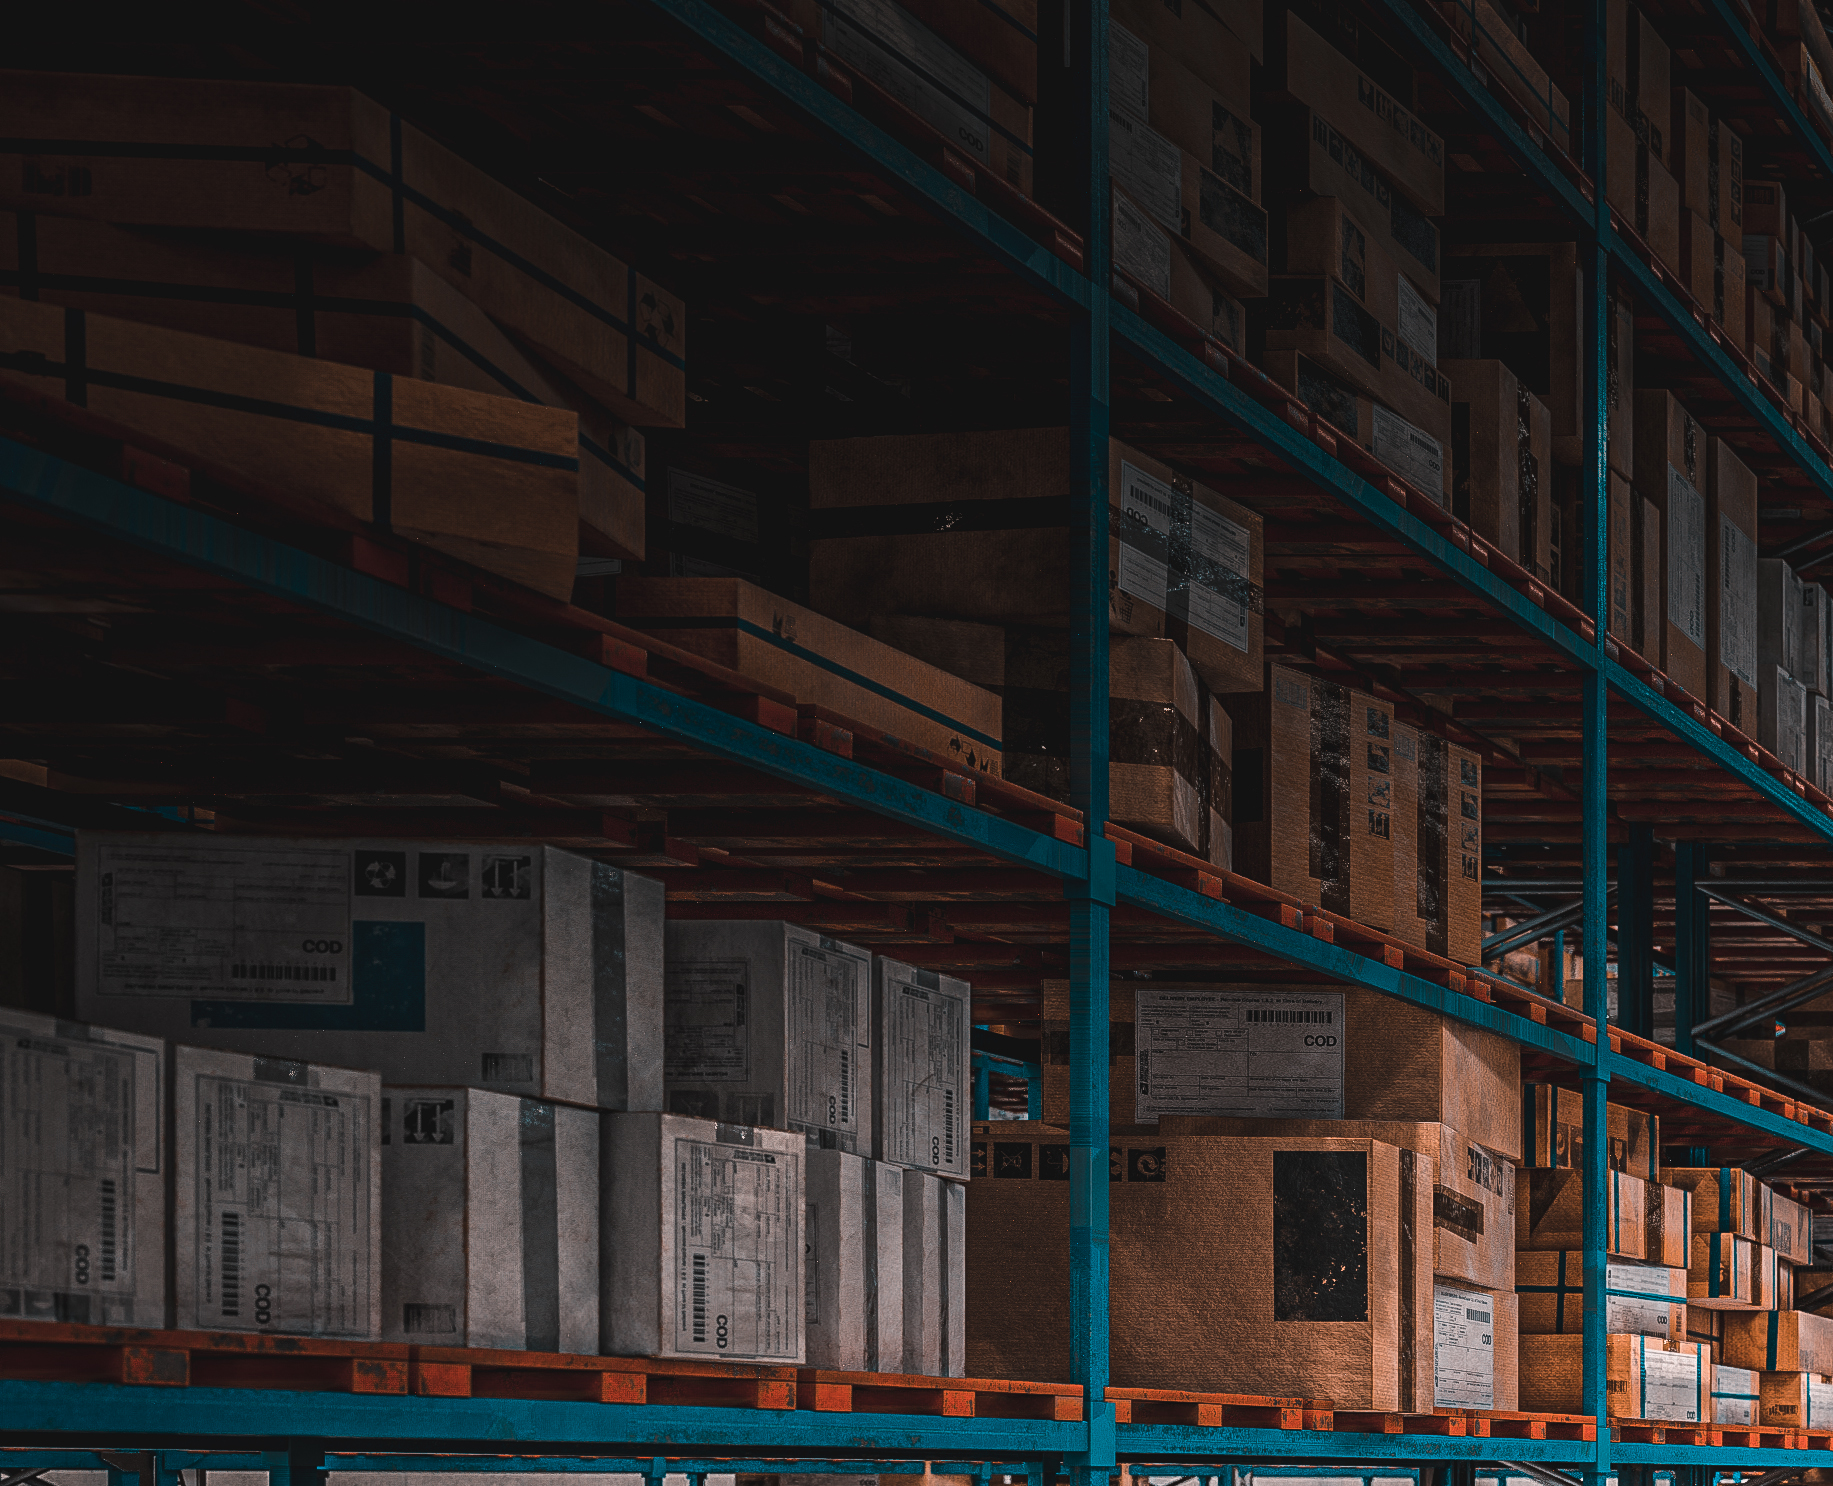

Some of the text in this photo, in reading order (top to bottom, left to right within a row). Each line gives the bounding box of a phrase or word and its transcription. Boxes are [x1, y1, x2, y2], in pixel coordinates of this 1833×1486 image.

[959, 127, 983, 152] COD
[302, 939, 342, 954] COD
[1304, 1033, 1337, 1047] COD
[828, 1095, 837, 1125] COD
[75, 1244, 89, 1284] COD
[255, 1284, 271, 1324] COD
[716, 1315, 728, 1349] COD
[1482, 1334, 1491, 1345] COD
